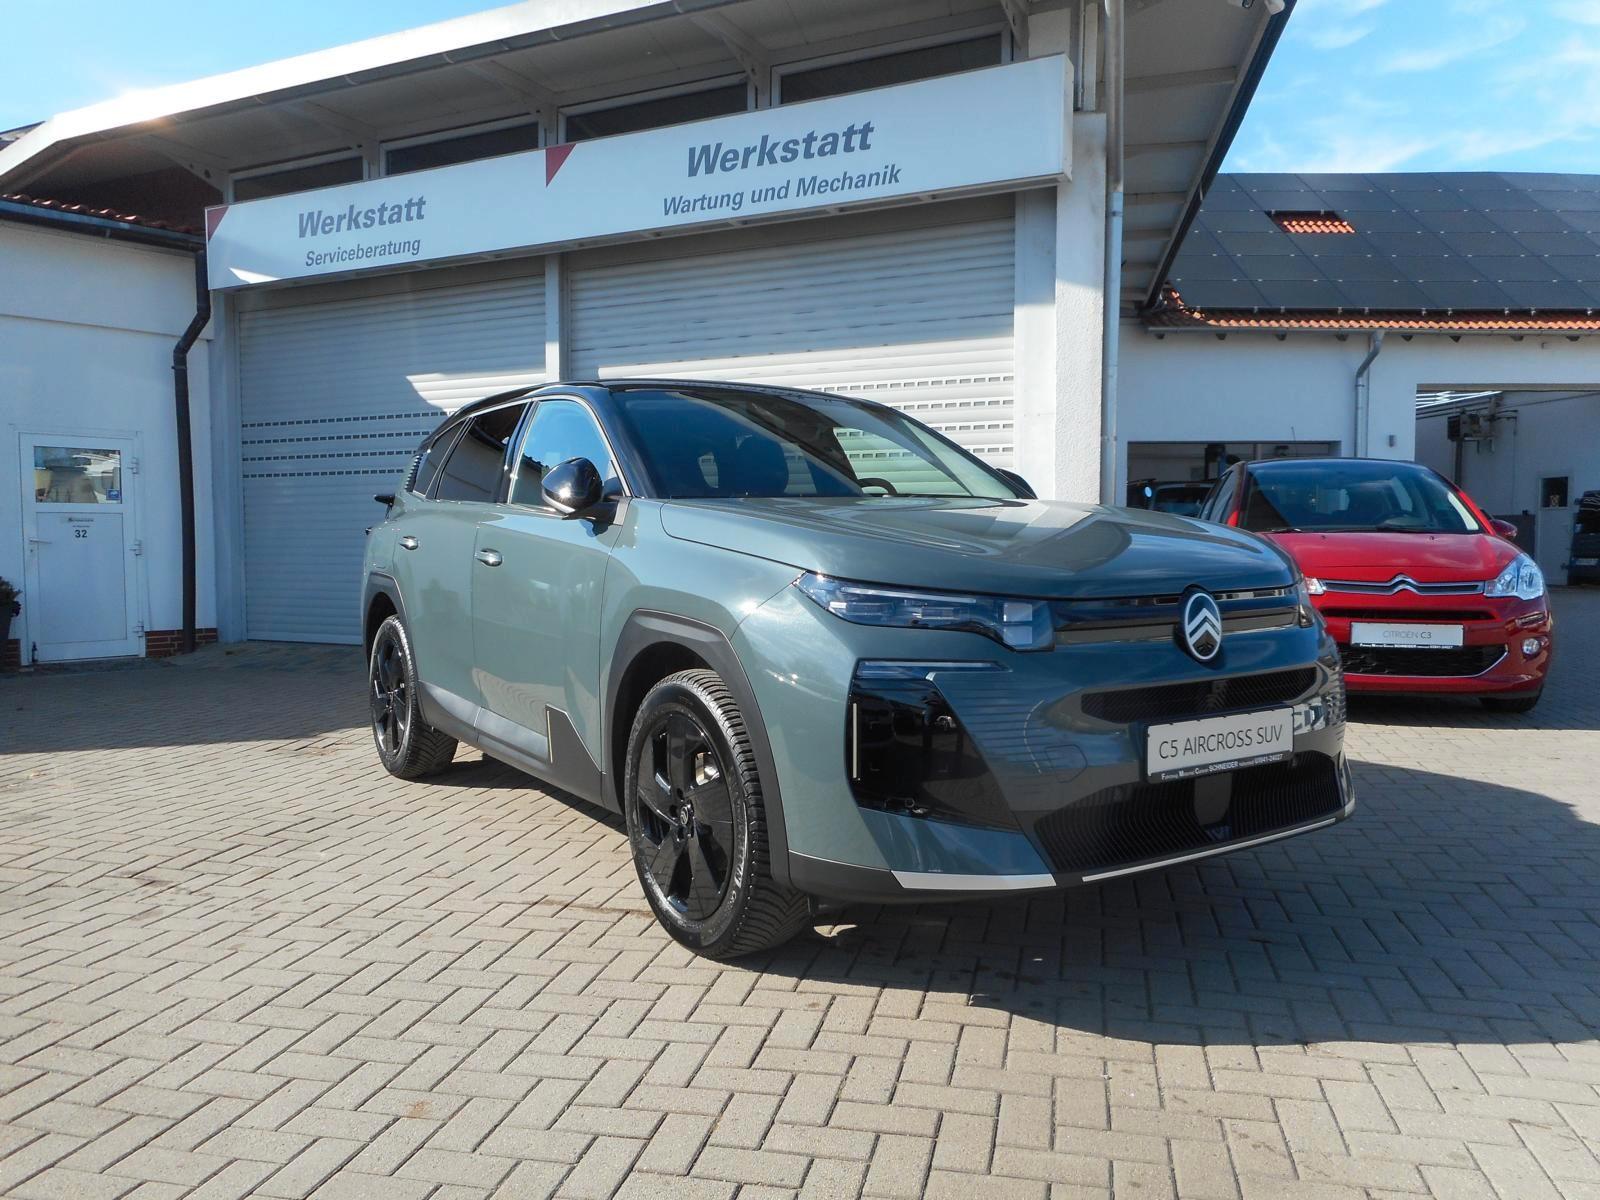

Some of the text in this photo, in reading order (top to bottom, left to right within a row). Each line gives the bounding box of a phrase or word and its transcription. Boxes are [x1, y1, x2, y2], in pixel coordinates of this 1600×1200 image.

[687, 121, 874, 178] Werkstatt
[663, 164, 902, 216] Wartung und Mechanik
[298, 195, 427, 239] Werkstatt
[305, 239, 421, 267] Serviceberatung
[75, 529, 88, 538] 32
[1420, 631, 1432, 640] C3
[1158, 724, 1284, 759] C5 AIRCROSS SUV
